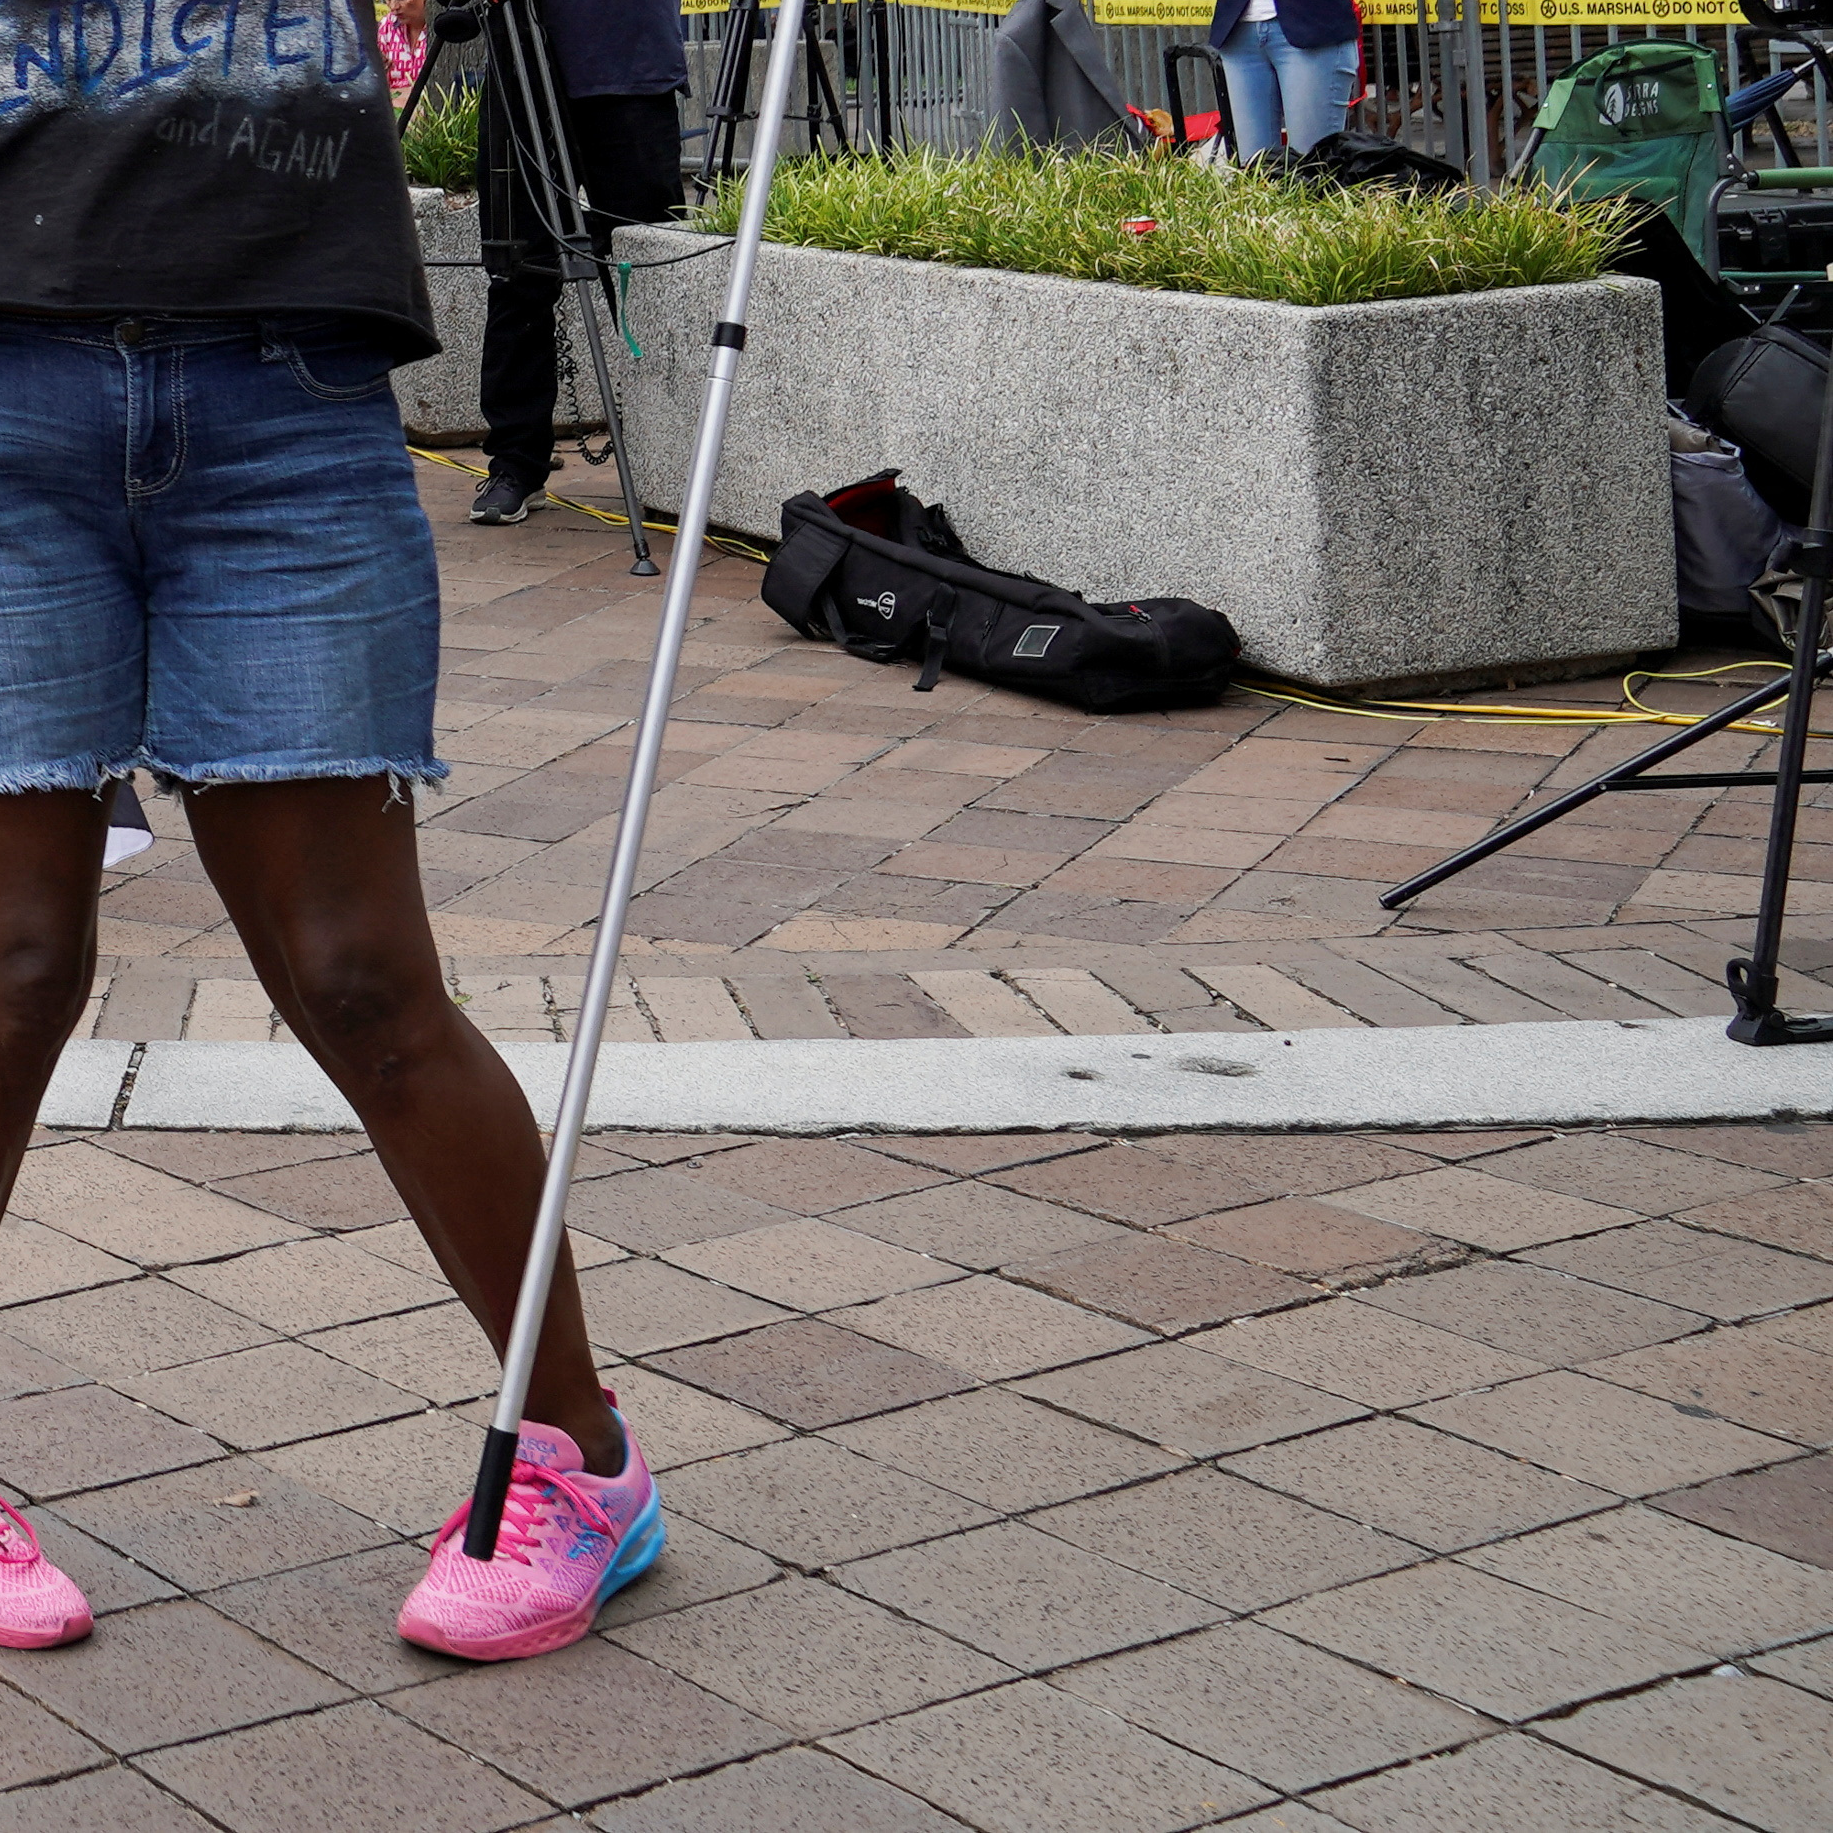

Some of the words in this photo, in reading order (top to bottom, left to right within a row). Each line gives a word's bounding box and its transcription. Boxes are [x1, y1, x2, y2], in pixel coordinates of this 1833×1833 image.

[1490, 2, 1525, 15] COSS
[1558, 3, 1584, 15] U.S.
[1586, 2, 1651, 15] MARSHAL
[1673, 1, 1692, 14] DO
[1696, 1, 1725, 14] NOT
[156, 109, 220, 149] and
[227, 116, 350, 181] AGAIN
